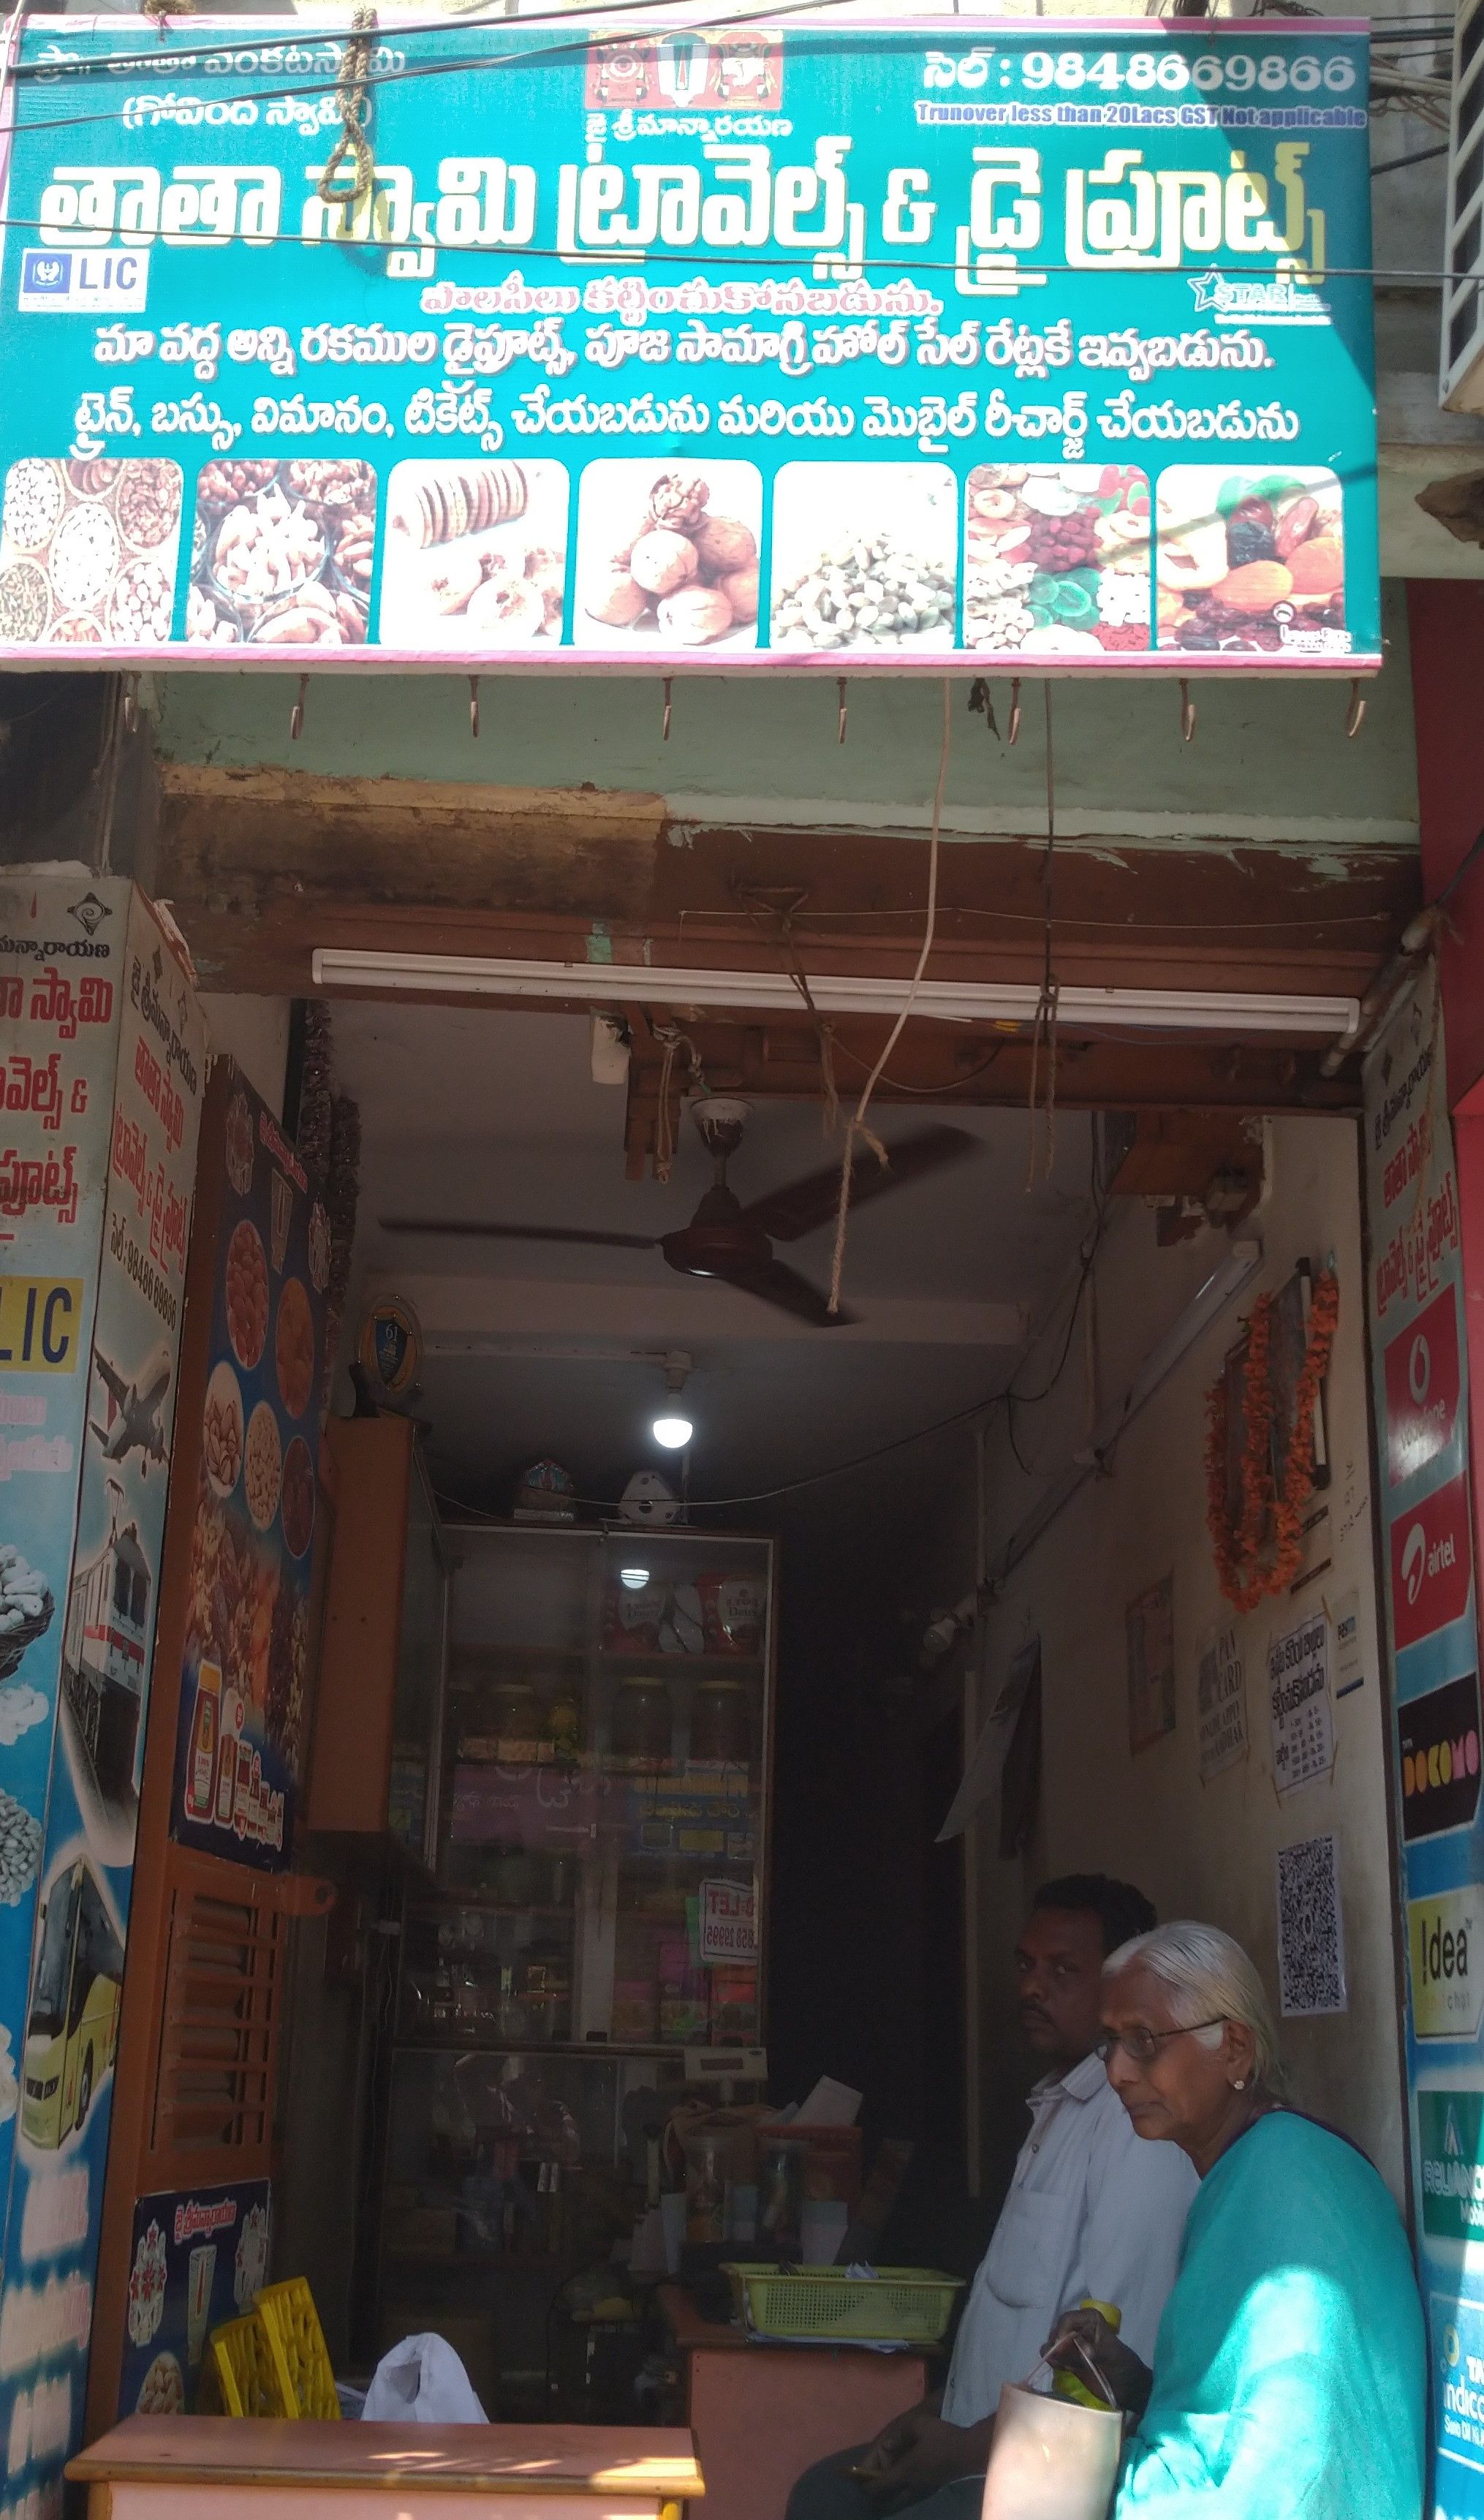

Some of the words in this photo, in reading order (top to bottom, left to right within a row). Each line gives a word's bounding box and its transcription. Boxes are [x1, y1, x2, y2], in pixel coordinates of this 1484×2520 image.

[1022, 52, 1356, 91] 9848669866
[917, 103, 1006, 123] Trunover
[1012, 104, 1053, 123] less
[1057, 105, 1102, 124] than
[1107, 105, 1176, 124] 20Lacs
[1181, 106, 1218, 126] GST
[1222, 106, 1254, 126] Not
[1257, 106, 1366, 127] applicable
[40, 165, 282, 247] తాతా
[882, 167, 936, 246] &
[79, 257, 137, 290] LIC
[95, 322, 154, 363] మా
[159, 322, 221, 380] వద్ద
[227, 325, 296, 377] అన్ని
[300, 322, 437, 363] రకముల
[71, 1078, 88, 1113] &
[1427, 1532, 1456, 1578] airtel
[1403, 1730, 1479, 1798] DOCOMO
